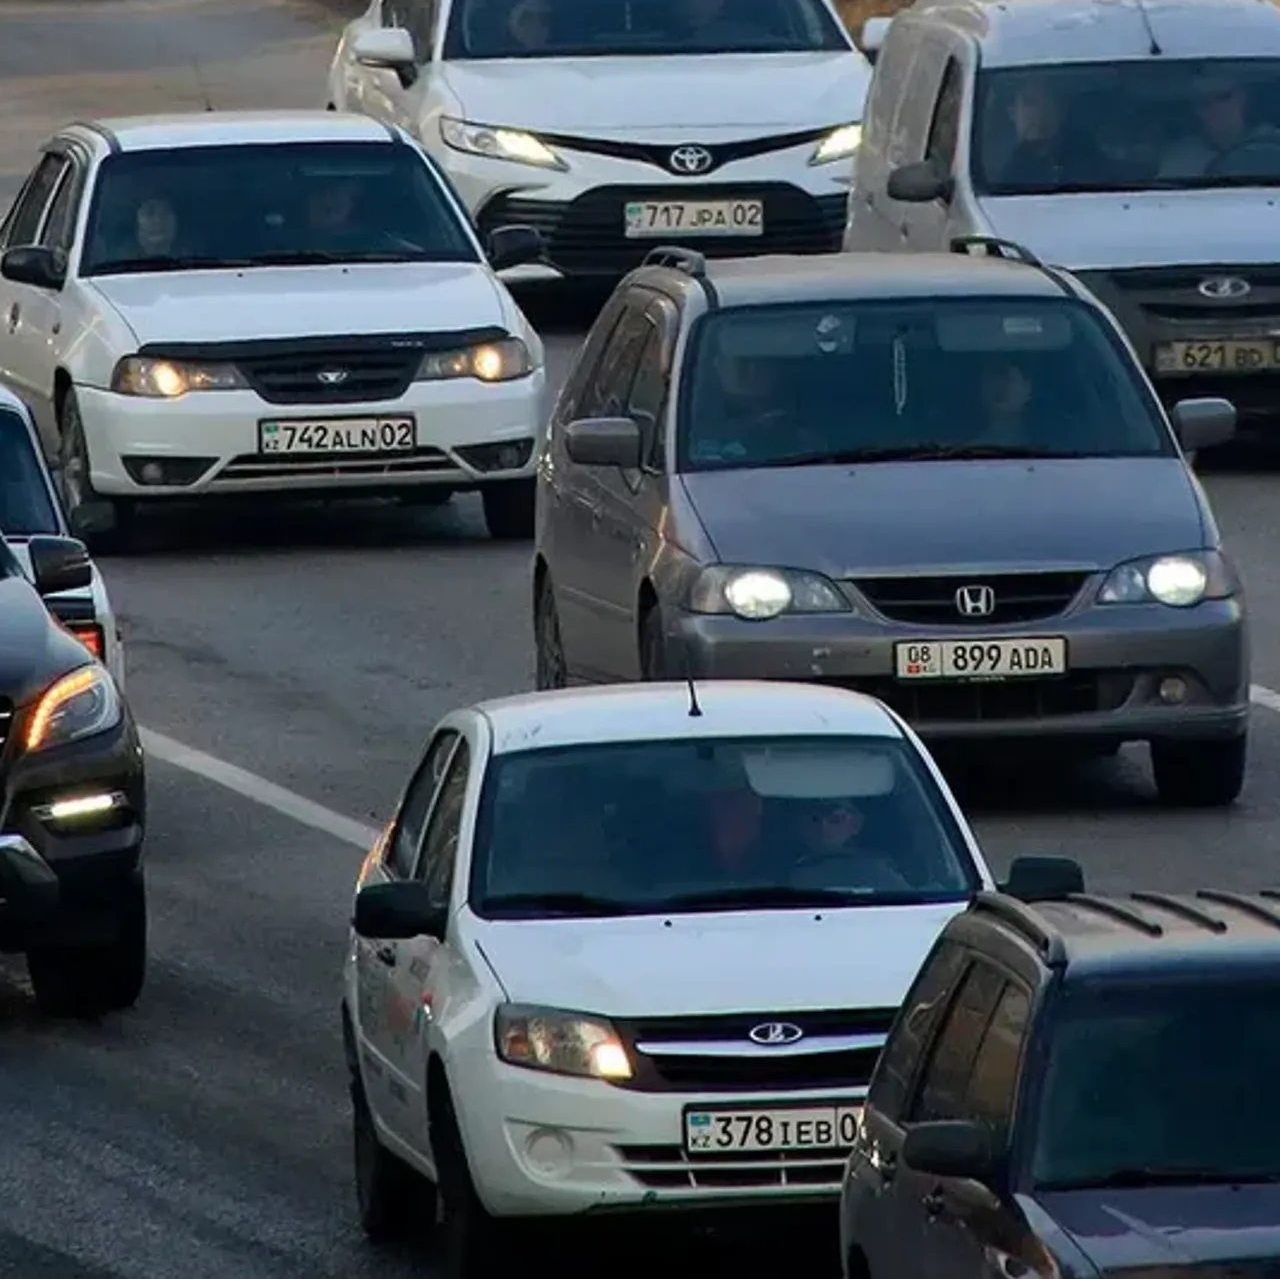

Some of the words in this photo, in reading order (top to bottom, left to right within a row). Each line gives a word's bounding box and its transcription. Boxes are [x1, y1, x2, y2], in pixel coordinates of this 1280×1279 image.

[645, 205, 685, 227] 717
[690, 208, 726, 227] JPA
[733, 204, 761, 226] 02
[1182, 345, 1226, 367] 621
[282, 425, 329, 450] 742
[332, 429, 376, 448] ALN
[381, 423, 411, 446] 02
[908, 646, 931, 664] 08
[953, 644, 1001, 671] 899
[1009, 647, 1053, 670] ADA
[715, 1115, 773, 1147] 378
[780, 1121, 833, 1145] IEB
